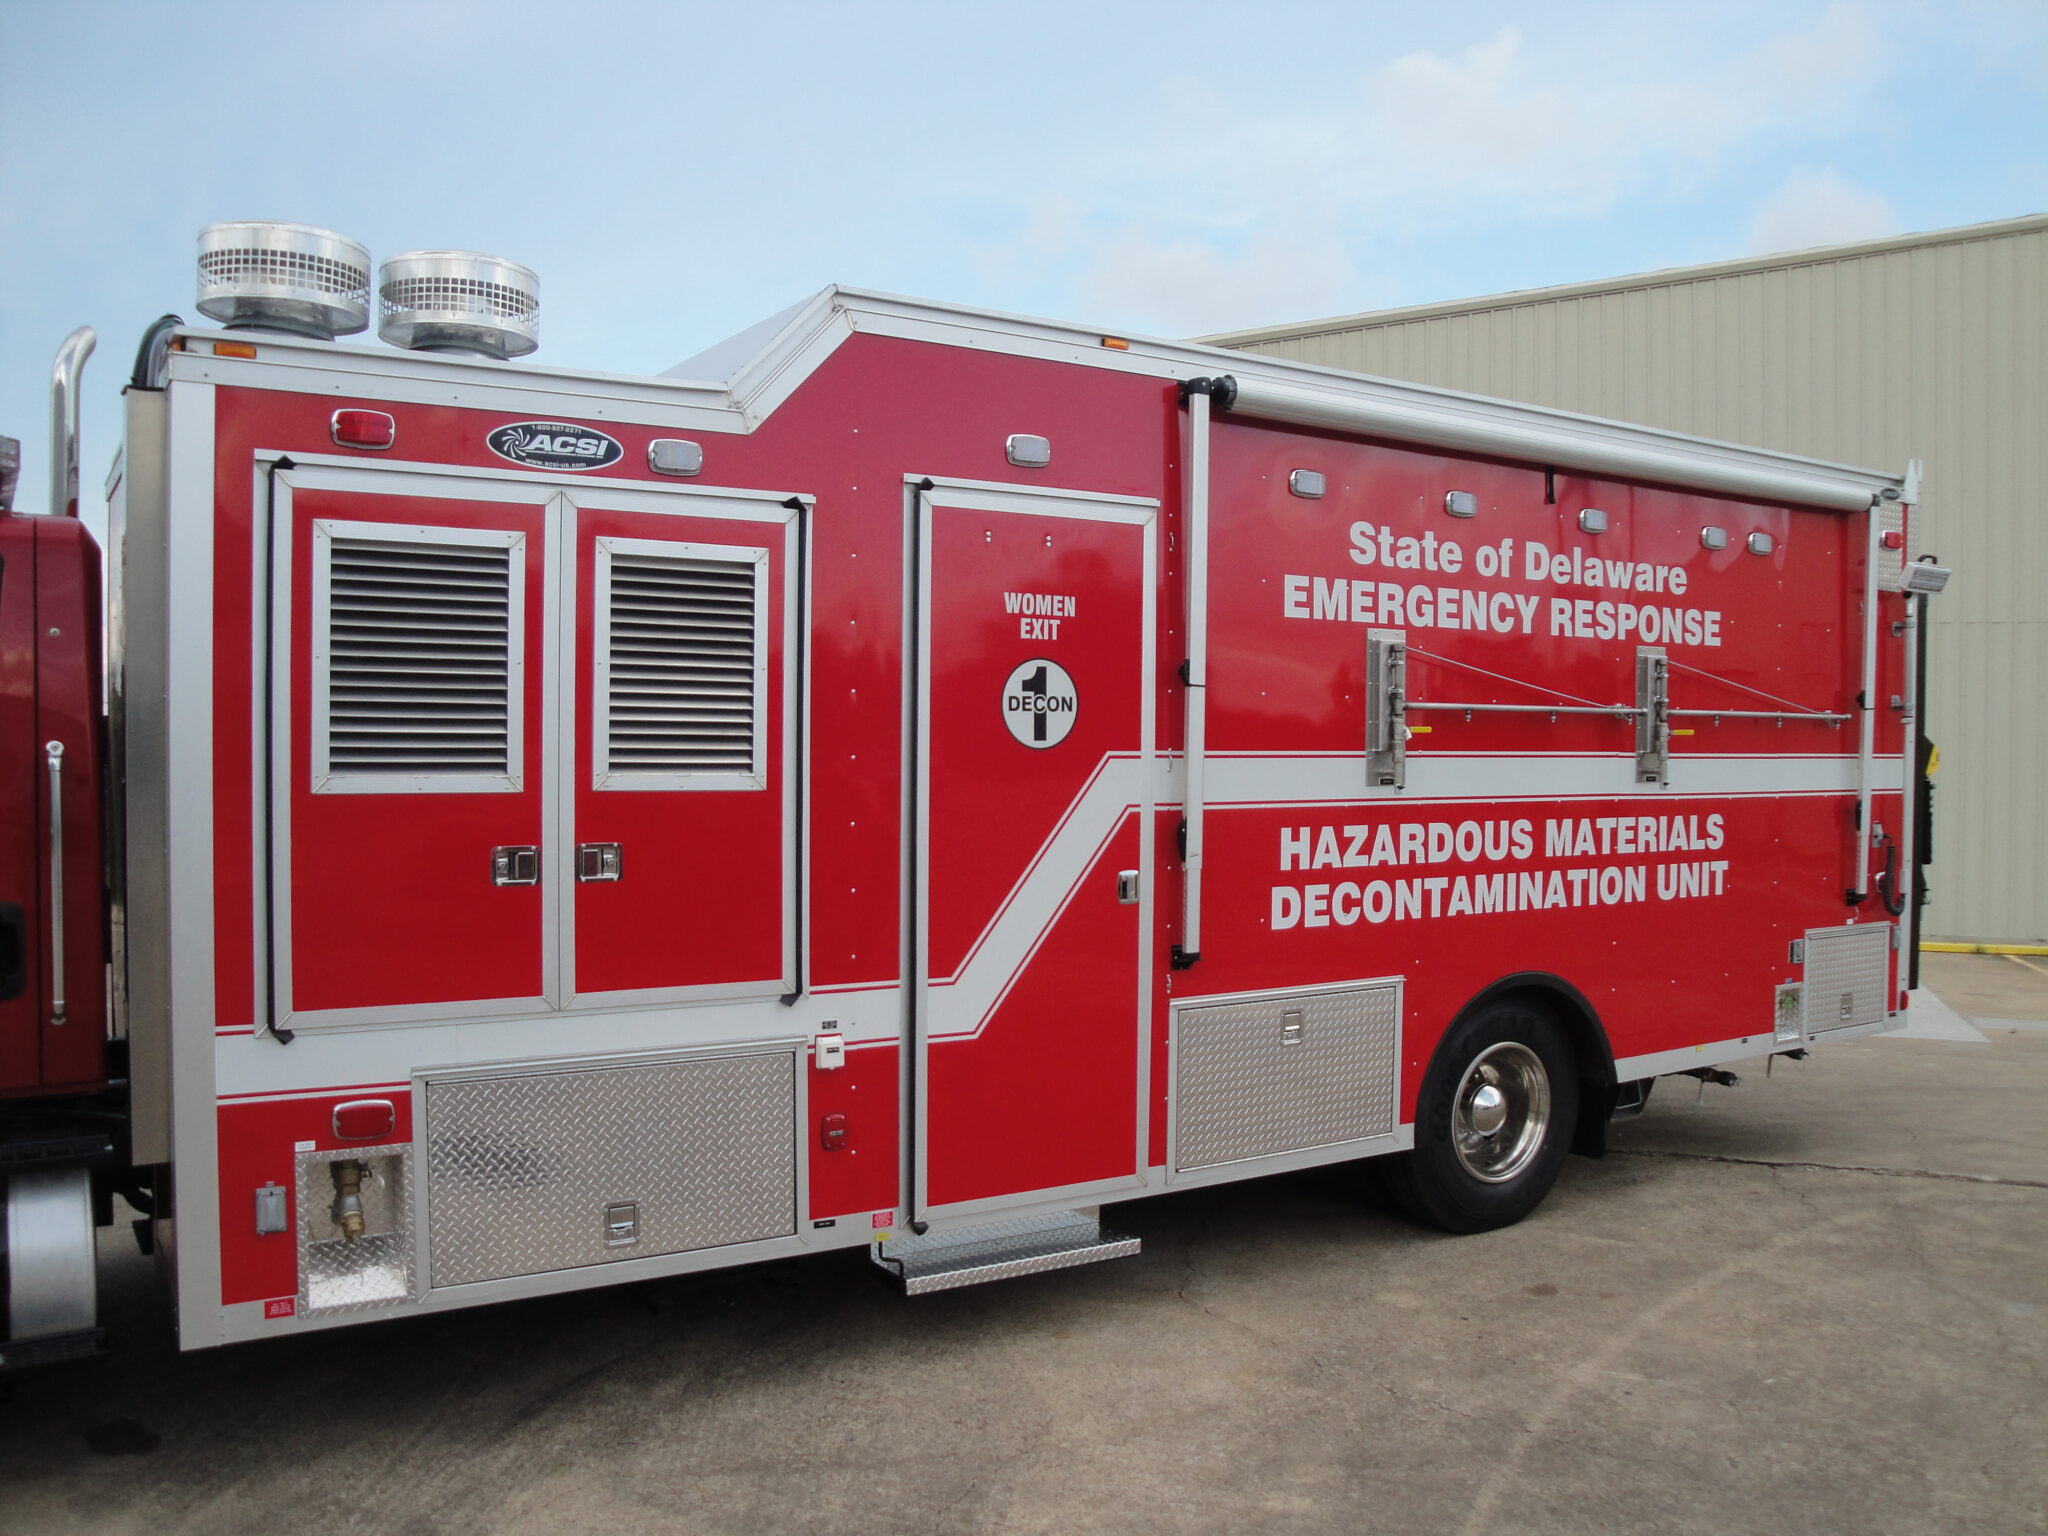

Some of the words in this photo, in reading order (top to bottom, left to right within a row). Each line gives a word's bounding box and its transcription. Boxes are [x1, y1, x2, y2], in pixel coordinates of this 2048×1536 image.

[525, 434, 609, 456] ACSI
[525, 457, 587, 469] www.acsi-us.com
[1349, 520, 1462, 573] State
[1476, 538, 1512, 577] of
[1525, 541, 1687, 595] Delaware
[1003, 592, 1076, 617] WOMEN
[1283, 574, 1539, 634] EMERGENCY
[1550, 598, 1722, 647] RESPONSE
[1020, 617, 1060, 640] EXIT
[1008, 695, 1073, 712] DECON
[1022, 666, 1047, 741] 1
[1280, 818, 1533, 871] HAZARDOUS
[1545, 813, 1724, 858] MATERIALS
[1270, 866, 1646, 931] DECONTAMINATION
[1657, 861, 1729, 900] UNIT
